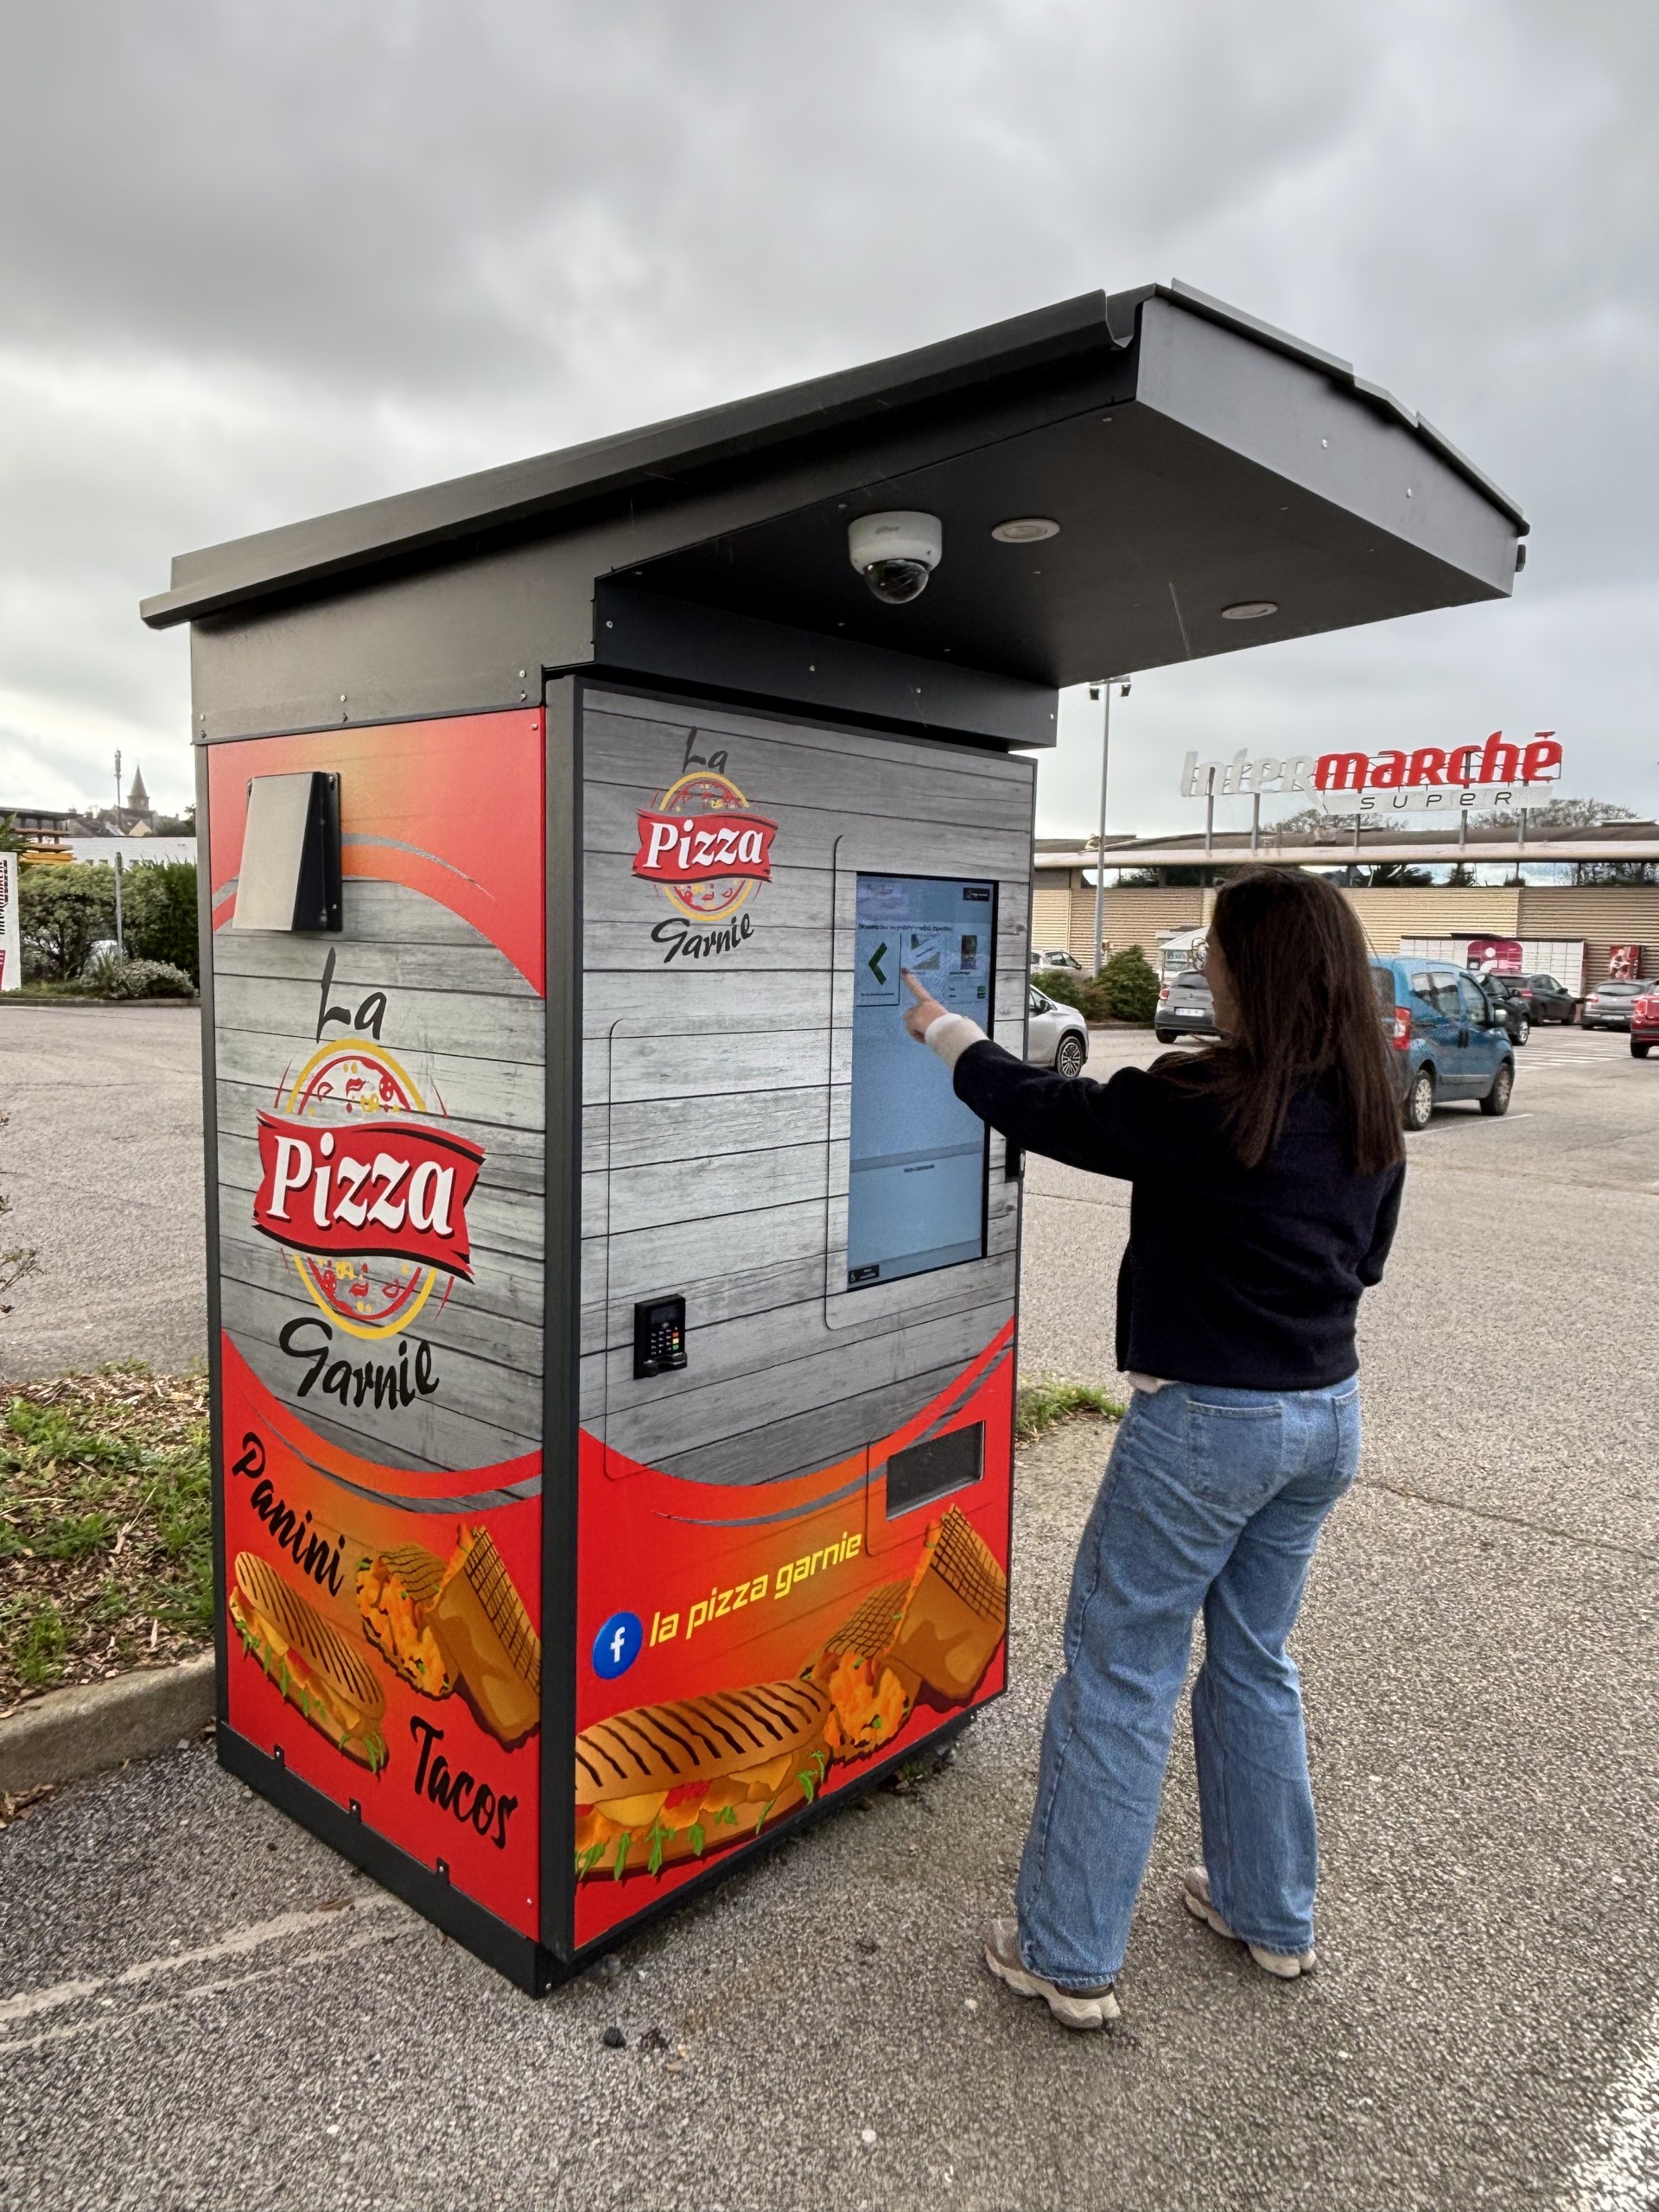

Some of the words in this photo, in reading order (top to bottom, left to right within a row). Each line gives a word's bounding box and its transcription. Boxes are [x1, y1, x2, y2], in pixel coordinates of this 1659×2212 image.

[683, 726, 728, 773] La
[642, 819, 764, 869] Pizza
[651, 912, 754, 963] Garnie
[316, 947, 387, 1043] La
[266, 1131, 454, 1236] Pizza
[278, 1317, 439, 1410] Garnie
[232, 1431, 346, 1597] Panini
[649, 1611, 679, 1647] la
[686, 1573, 769, 1640] pizza
[774, 1531, 862, 1599] garnie
[410, 1715, 518, 1849] Tacos
